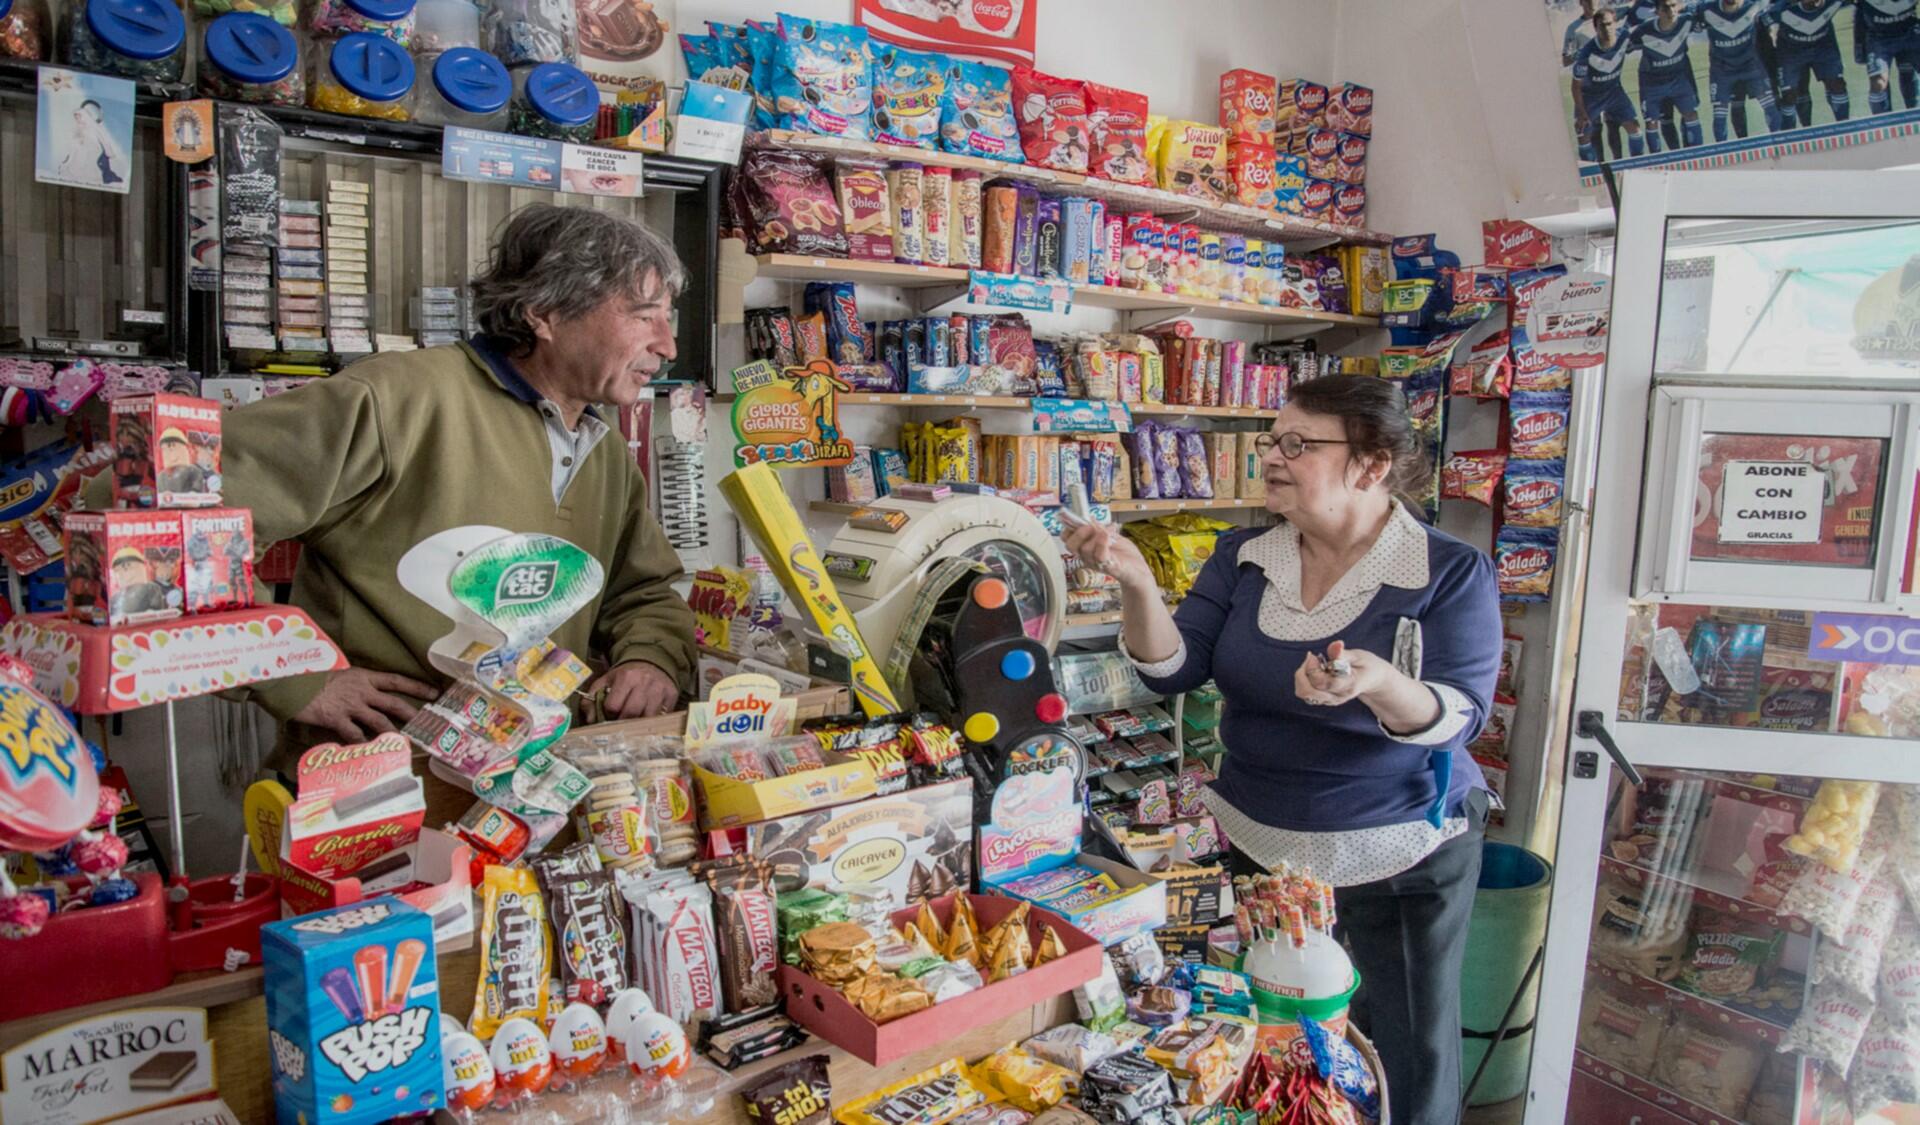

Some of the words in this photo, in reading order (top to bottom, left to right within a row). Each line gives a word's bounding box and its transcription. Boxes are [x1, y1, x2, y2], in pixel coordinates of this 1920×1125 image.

[1245, 88, 1271, 112] Rex
[576, 149, 601, 158] FUMAR
[603, 152, 627, 160] CAUSA
[1245, 162, 1272, 184] Rex
[1500, 227, 1535, 252] Saladix
[1399, 288, 1414, 300] BC
[1561, 285, 1602, 302] bueno
[1562, 316, 1596, 329] bueno
[736, 363, 766, 379] NUEVO
[1389, 357, 1405, 370] BC
[737, 374, 773, 391] RE-MIX!
[157, 403, 219, 421] ROBLOX
[1513, 414, 1561, 438] Saladix
[814, 444, 850, 459] JIRAFA
[1745, 466, 1807, 477] ABONE
[1508, 480, 1556, 506] Saladix
[1755, 488, 1793, 498] CON
[191, 516, 245, 533] FORTNITE
[1737, 509, 1807, 520] CAMBIO
[108, 521, 179, 537] ROBLOX
[1747, 531, 1793, 540] GRACIAS
[1498, 548, 1548, 573] Saladix
[516, 566, 549, 584] tic
[507, 581, 546, 596] tac
[168, 664, 181, 673] con
[183, 662, 201, 672] una
[203, 657, 239, 670] sonrisa?
[1080, 664, 1137, 695] topline
[715, 693, 772, 717] baby
[716, 713, 765, 735] doll
[302, 737, 406, 775] Barrita
[826, 810, 874, 840] ALFAJORES
[309, 823, 403, 861] Barrita
[741, 889, 776, 971] MANTECOL
[1692, 947, 1737, 966] Saladix
[676, 926, 714, 1008] MANTECOL
[320, 1006, 433, 1065] PUSH
[22, 1018, 187, 1082] MARROC
[341, 1035, 425, 1084] POP
[784, 1079, 811, 1102] tri
[774, 1088, 828, 1125] SHOT
